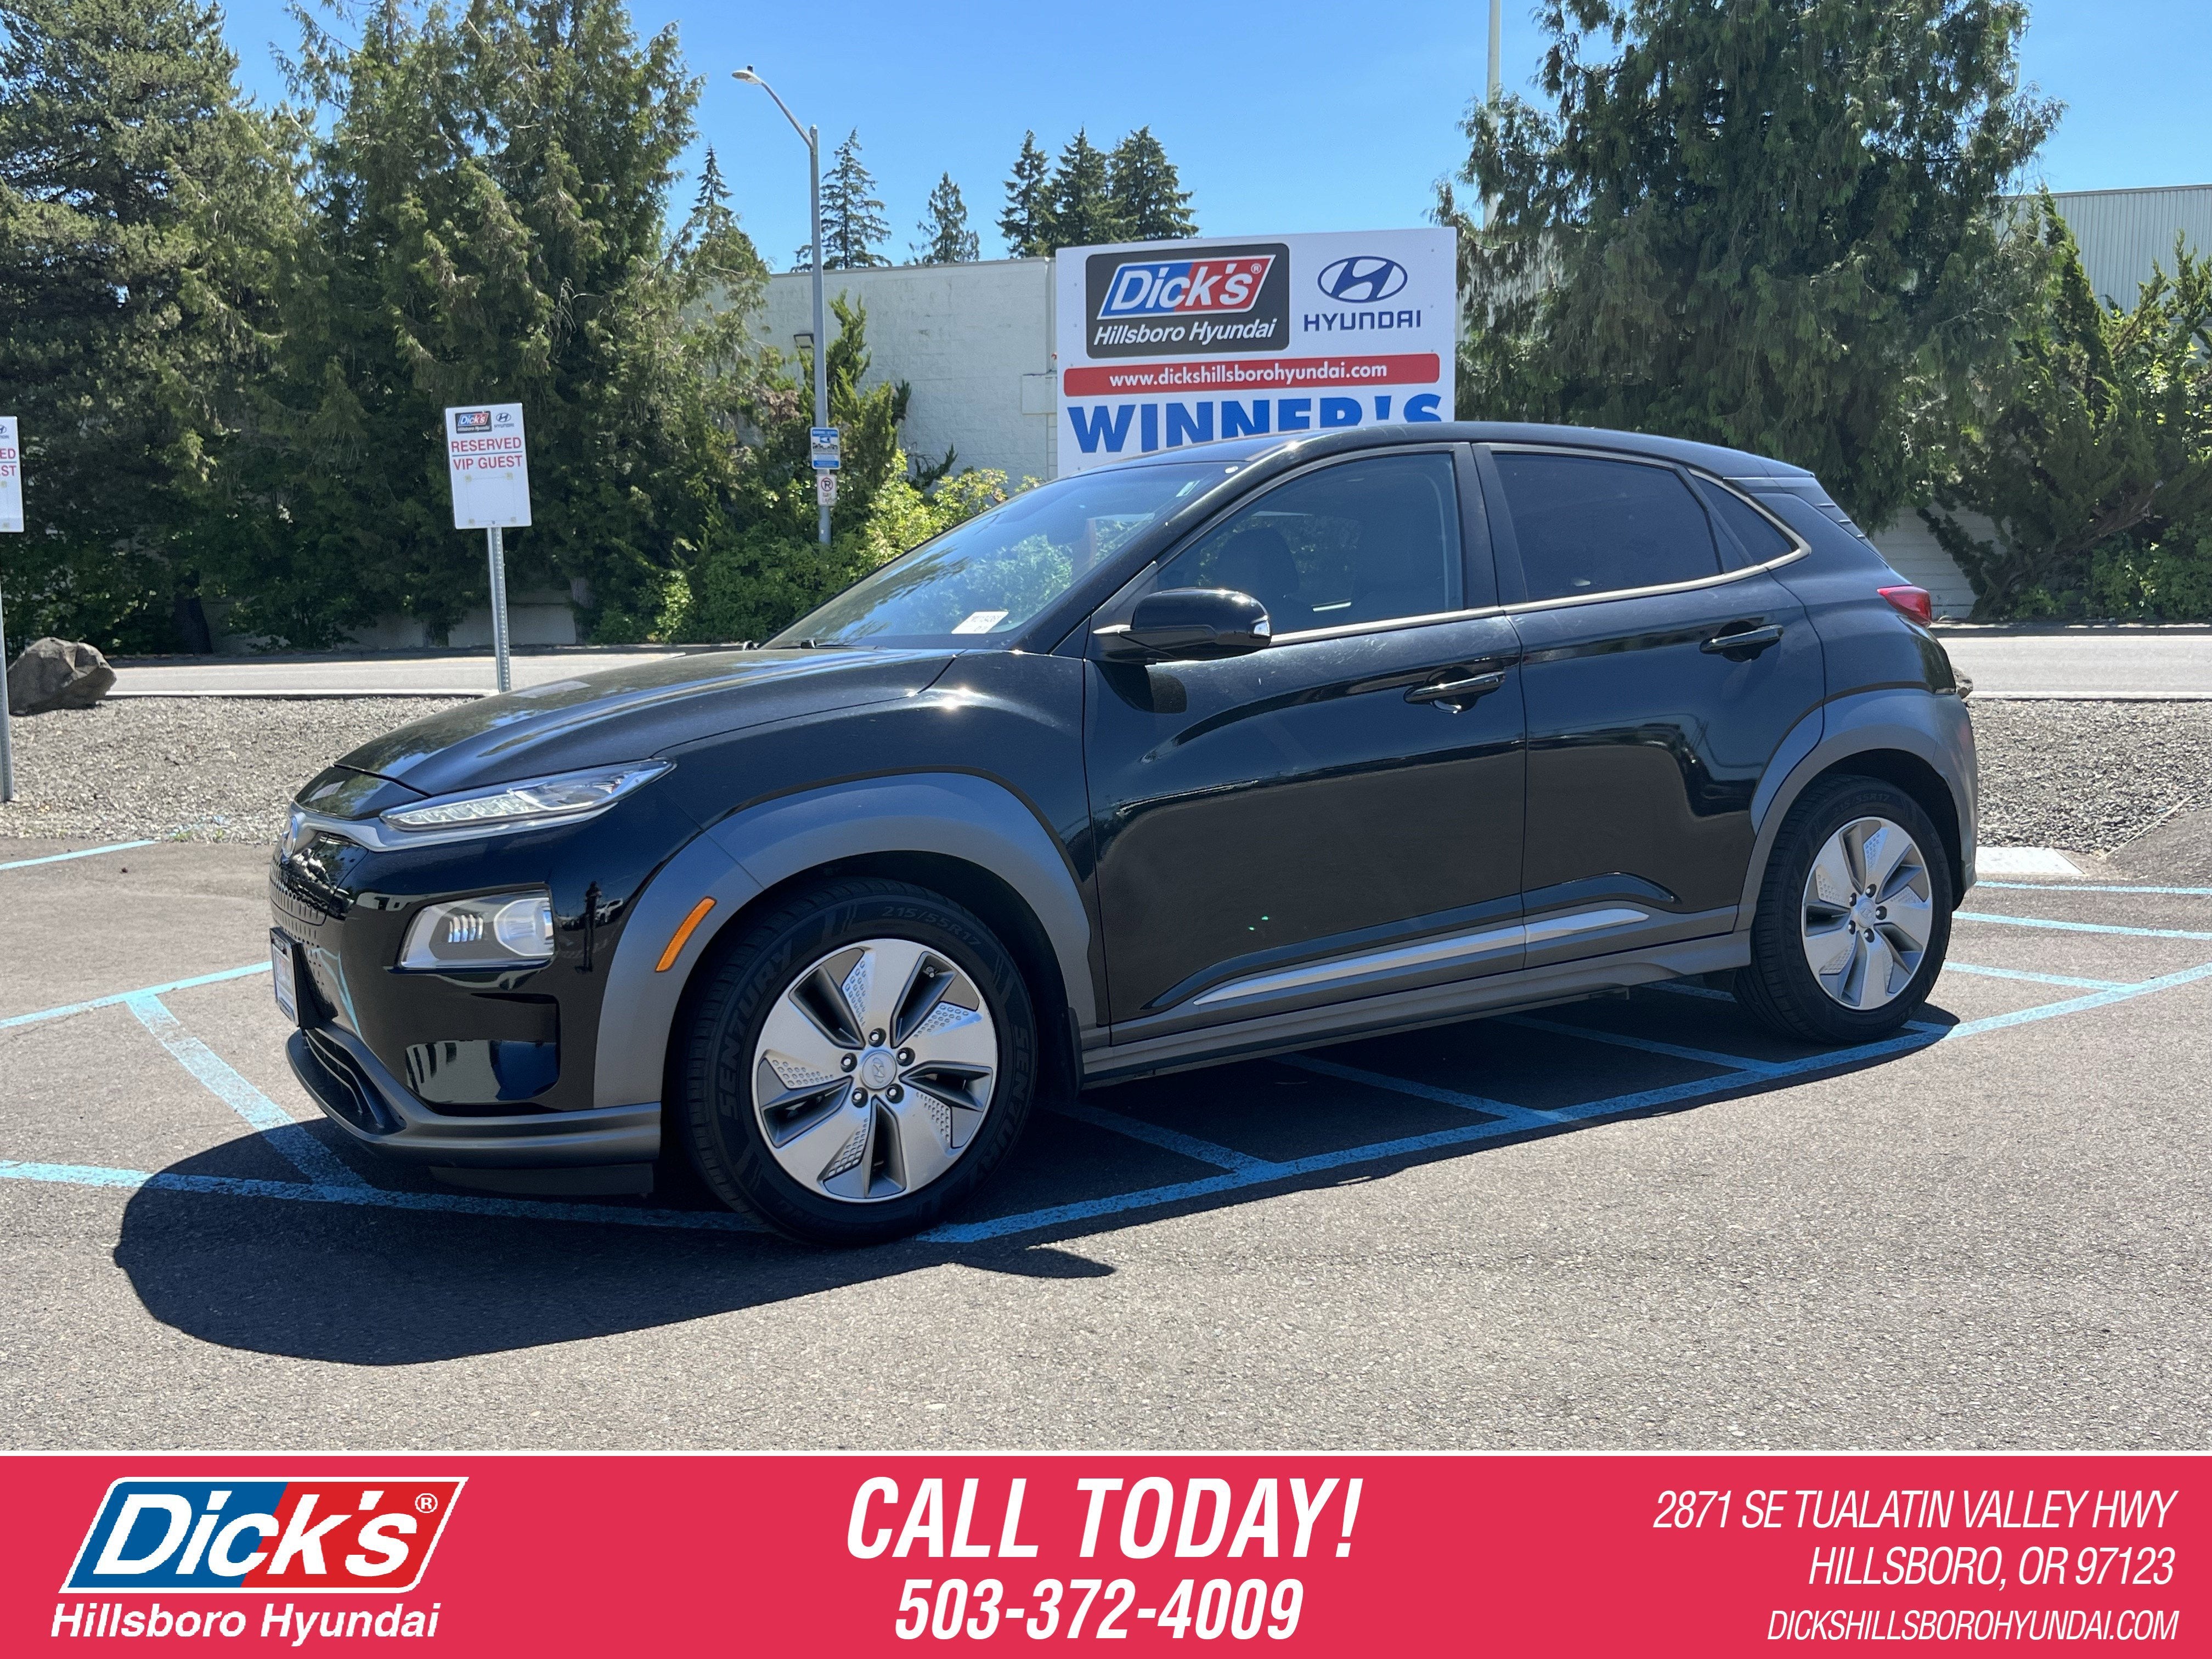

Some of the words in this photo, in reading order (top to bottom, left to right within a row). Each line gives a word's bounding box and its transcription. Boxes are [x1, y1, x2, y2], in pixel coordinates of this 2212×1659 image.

[1110, 263, 1253, 311] Dick's
[1093, 324, 1186, 346] Hillsboro
[1188, 318, 1278, 346] Hyundai
[1304, 309, 1421, 332] HYUNDAI
[1109, 362, 1387, 387] www.dickshillsborohyundai.com
[451, 437, 522, 453] RESERVED
[453, 458, 473, 470] VIP
[478, 455, 522, 470] GUEST
